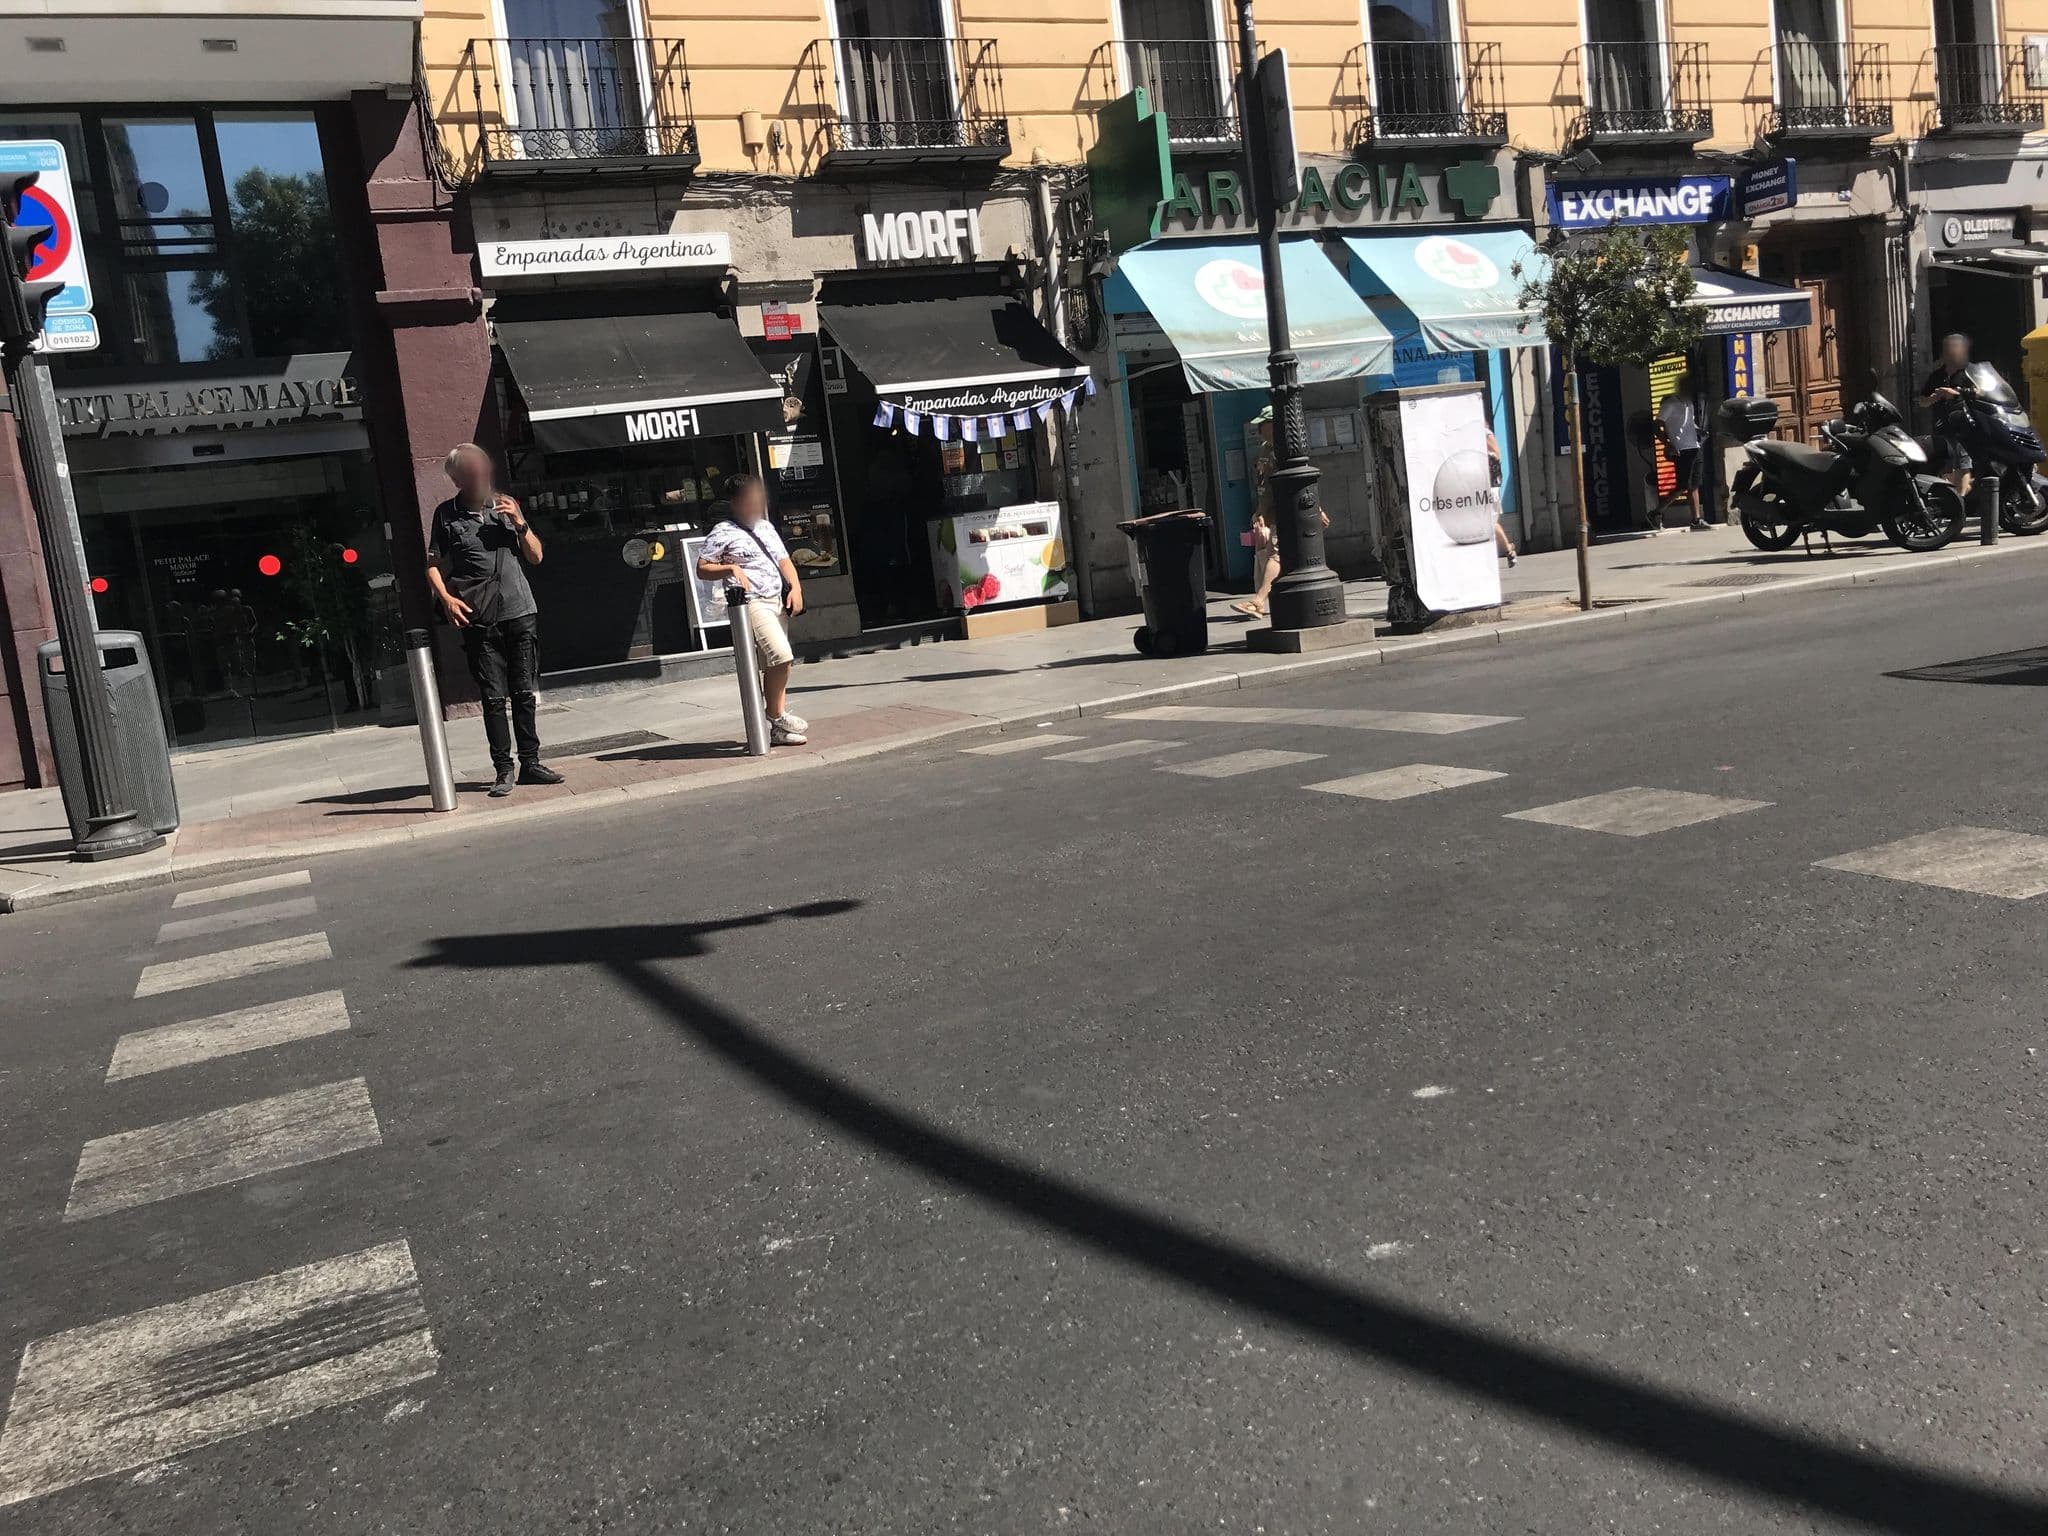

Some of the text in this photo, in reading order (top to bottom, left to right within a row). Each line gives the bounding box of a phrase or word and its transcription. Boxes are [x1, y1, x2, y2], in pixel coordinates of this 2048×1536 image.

[1745, 176, 1786, 194] EXCHANGE
[1751, 166, 1779, 181] MONEY
[1166, 162, 1430, 219] ARACIA
[1561, 185, 1713, 221] EXCHANGE
[862, 208, 982, 262] MORFI
[495, 240, 717, 272] Empanadas Argentinas
[52, 335, 92, 345] 0101022
[1733, 333, 1749, 400] HANG
[124, 386, 235, 420] PALACE
[904, 384, 1066, 416] Empanadas Argentinas
[625, 408, 700, 442] MORFI
[1419, 496, 1453, 512] Orbs
[1455, 495, 1472, 509] en
[153, 554, 210, 566] PETIT PALACE
[170, 562, 198, 570] MAYOR
